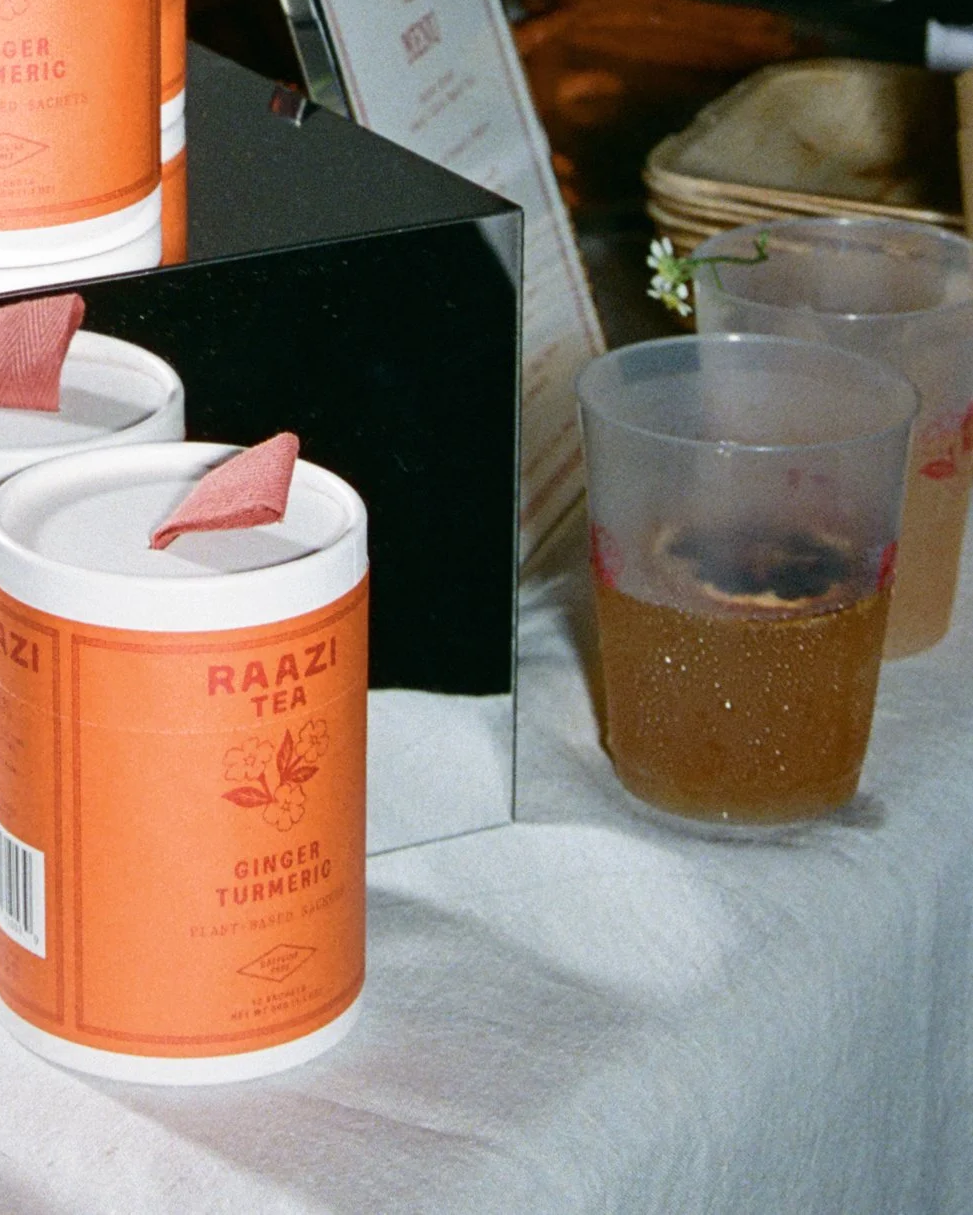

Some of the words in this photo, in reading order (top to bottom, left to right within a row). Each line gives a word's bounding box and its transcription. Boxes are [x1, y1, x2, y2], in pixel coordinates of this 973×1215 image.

[207, 636, 337, 696] RAAZI
[250, 686, 307, 718] TEA
[234, 840, 320, 880] GINGER
[215, 858, 332, 908] TURMERIC
